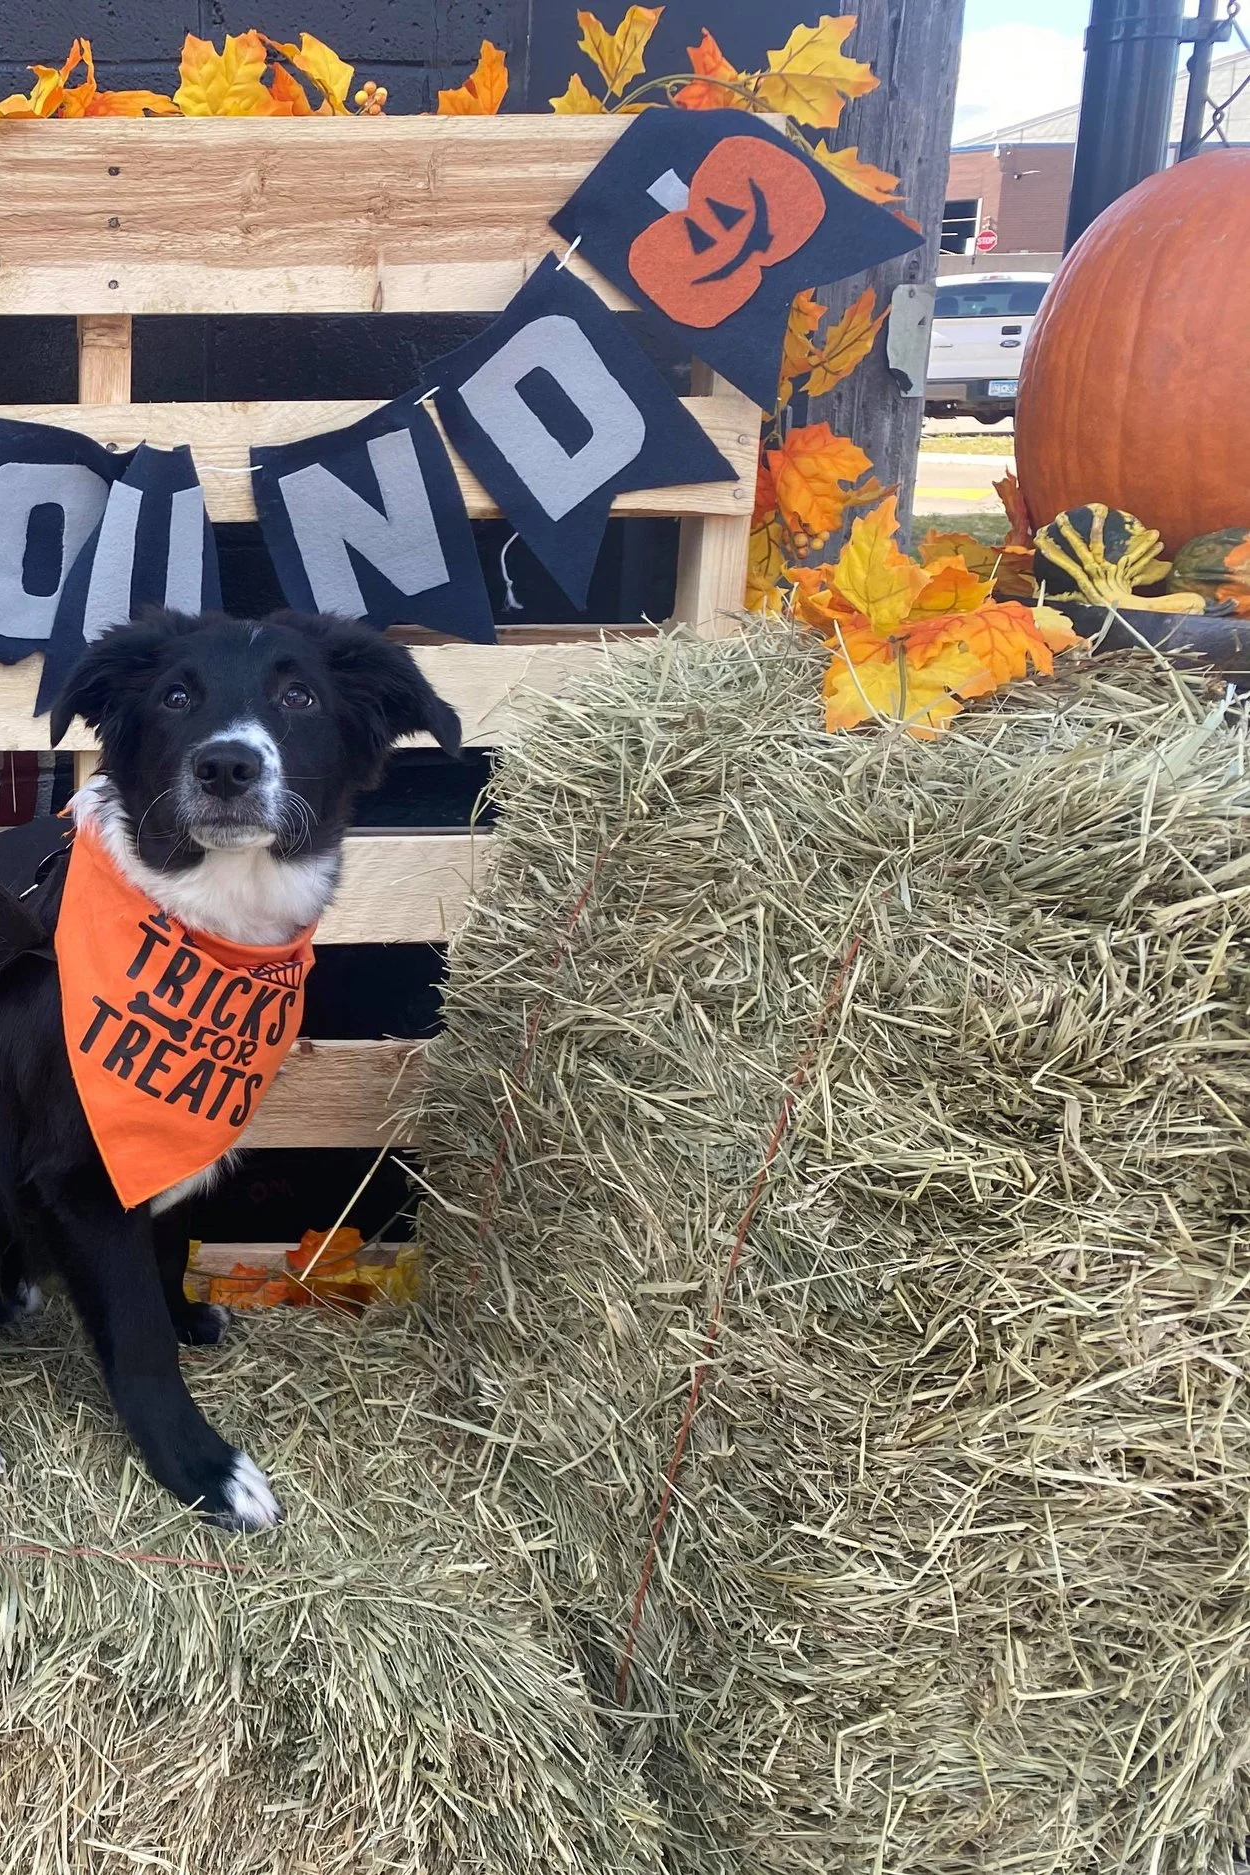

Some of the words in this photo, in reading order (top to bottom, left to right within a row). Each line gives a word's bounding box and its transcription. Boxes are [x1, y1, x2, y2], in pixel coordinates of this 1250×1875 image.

[977, 236, 996, 246] STOP
[126, 921, 296, 1046] TRICKS
[79, 995, 263, 1127] TREATS
[190, 1029, 258, 1066] FOR
